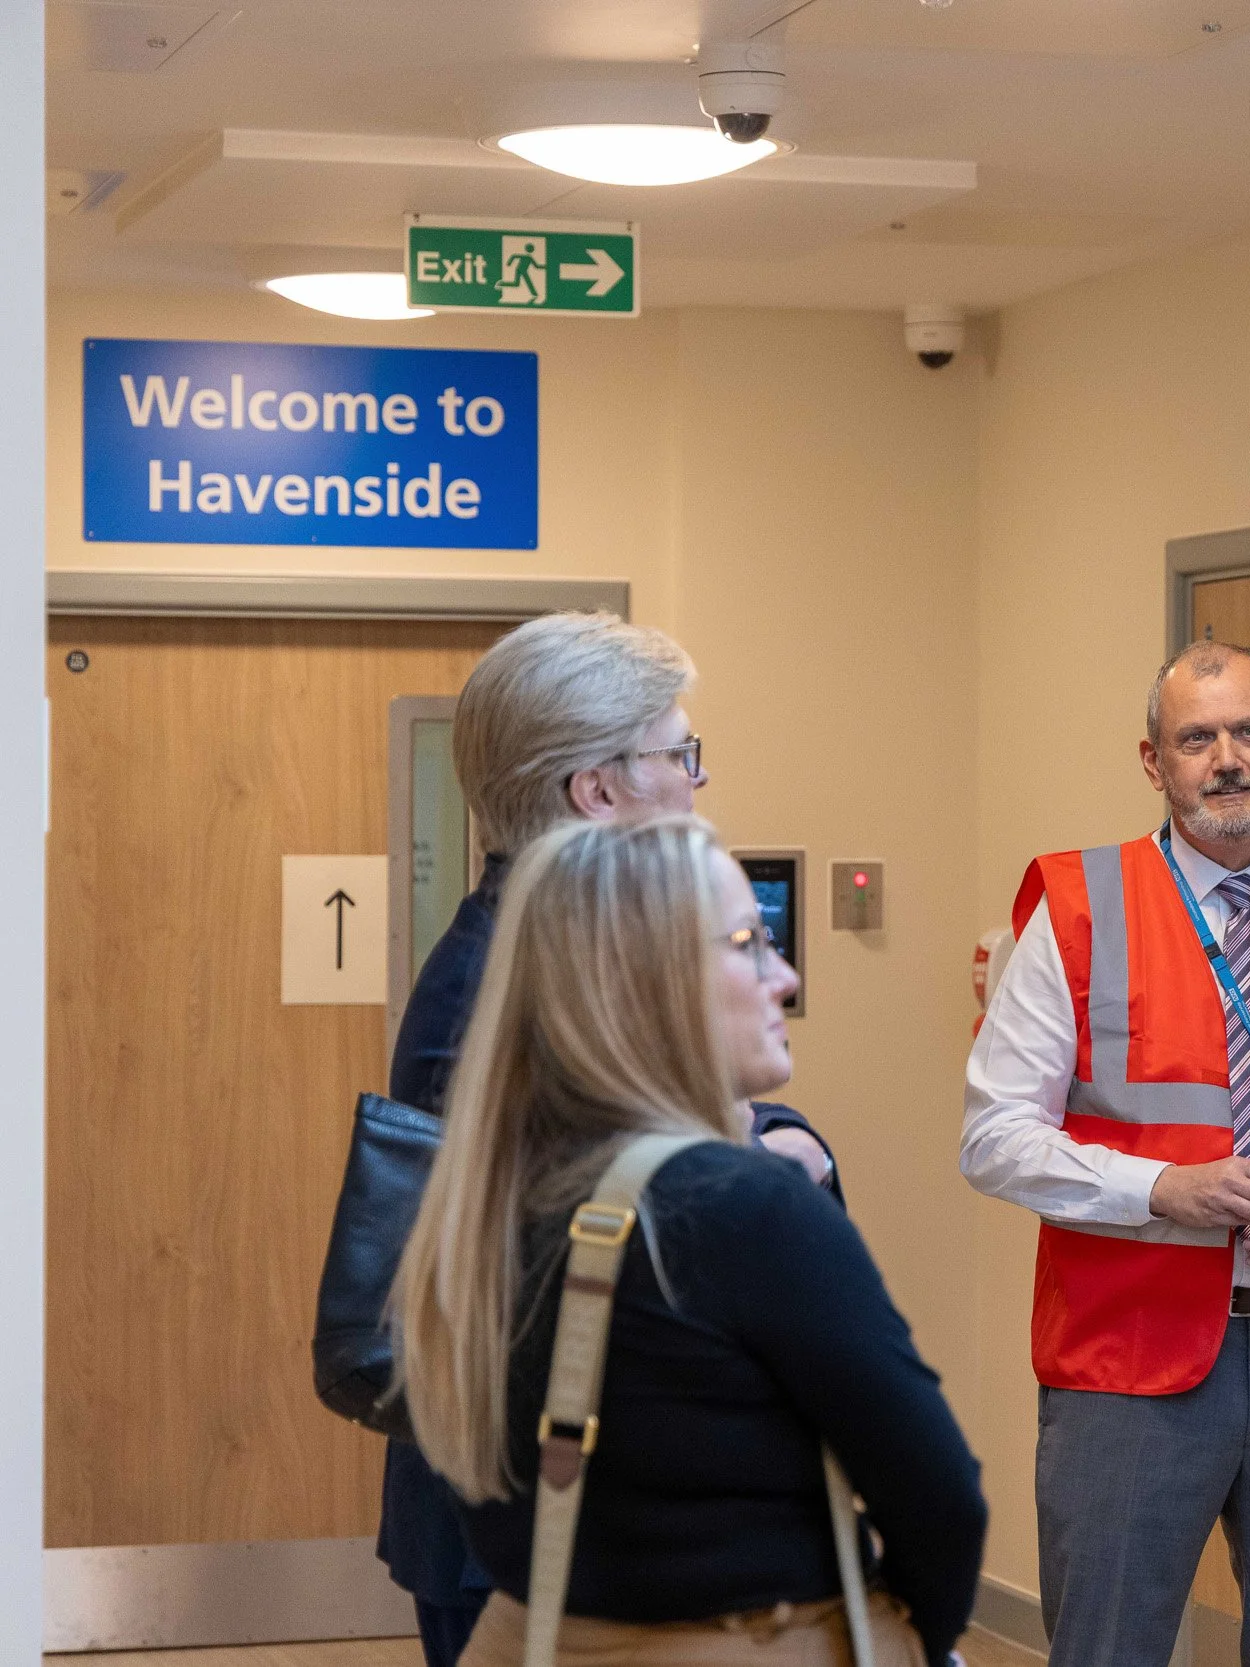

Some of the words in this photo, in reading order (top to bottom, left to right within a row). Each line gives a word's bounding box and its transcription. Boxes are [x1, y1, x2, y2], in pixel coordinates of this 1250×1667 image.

[417, 250, 487, 285] Exit
[120, 373, 418, 435] Welcome
[437, 386, 505, 437] to
[149, 459, 481, 520] Havenside
